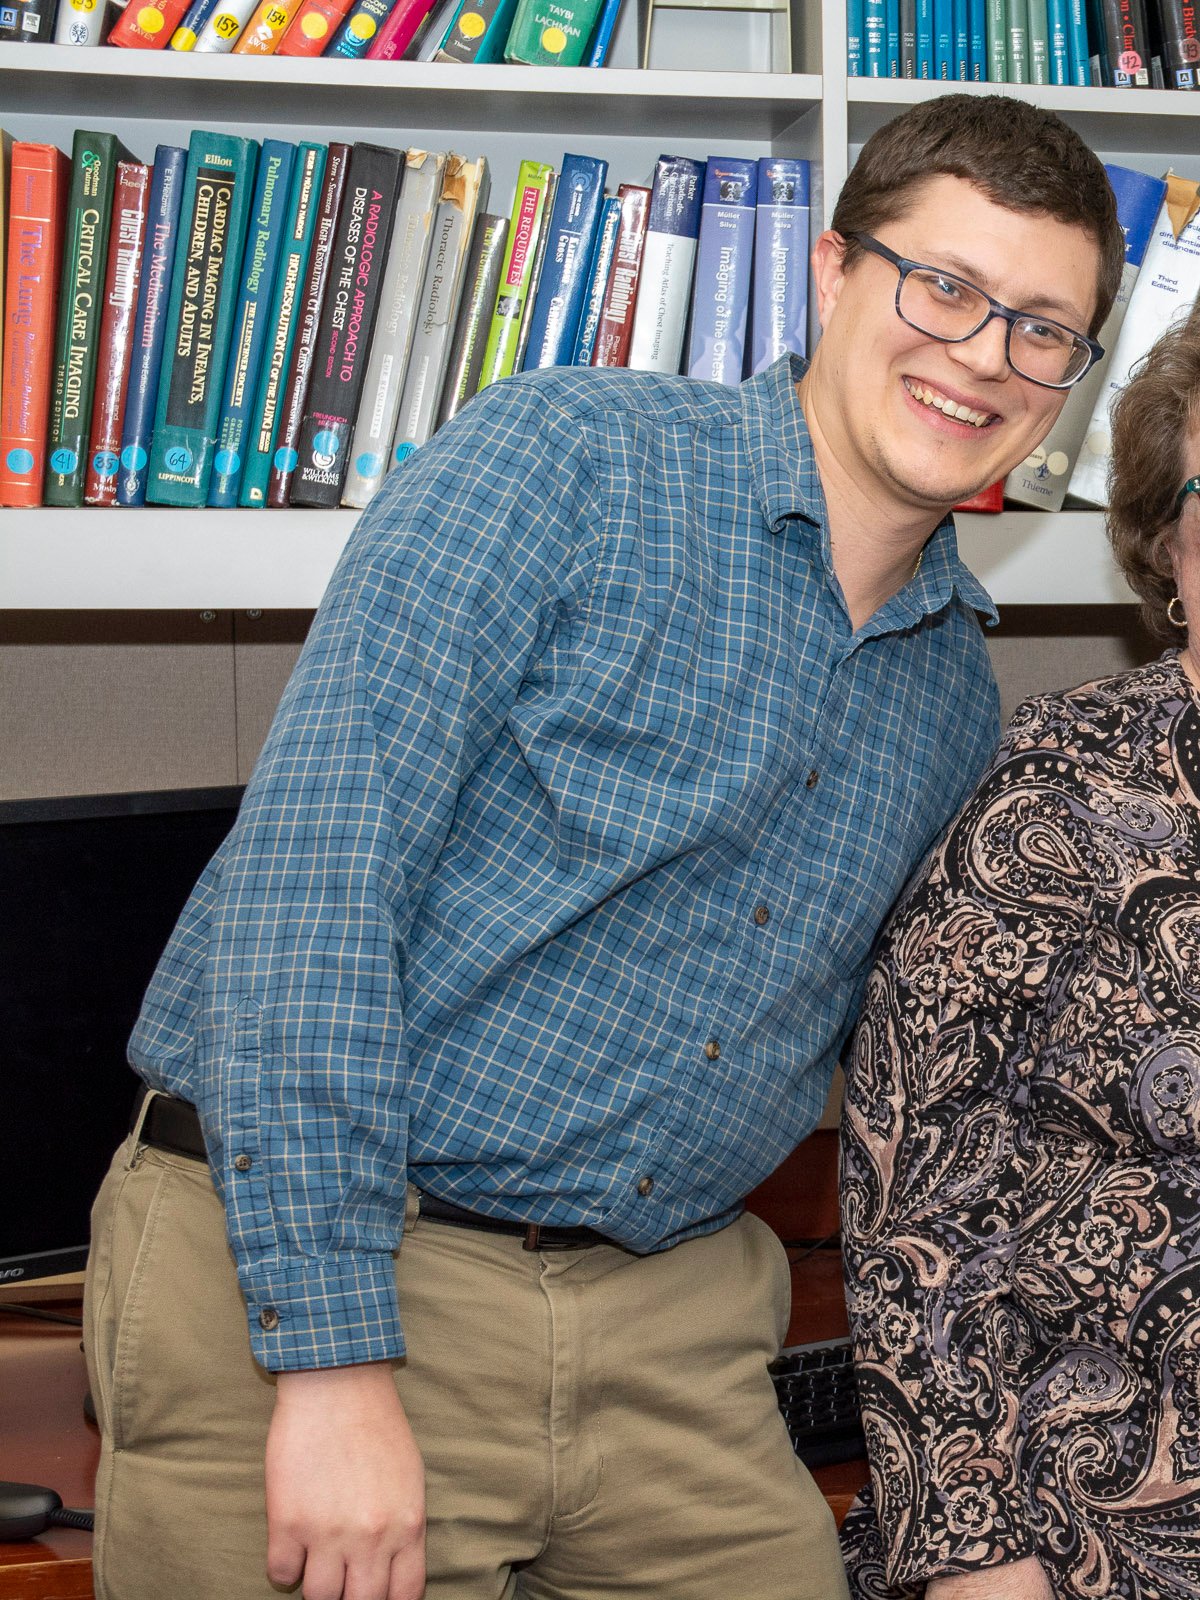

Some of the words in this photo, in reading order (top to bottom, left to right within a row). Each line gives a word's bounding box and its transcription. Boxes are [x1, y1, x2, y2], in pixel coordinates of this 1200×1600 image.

[268, 10, 285, 26] 154
[361, 1, 384, 17] EDITION
[549, 4, 574, 20] TAYBI
[216, 16, 239, 37] 157
[535, 14, 581, 37] LACHMAN
[1122, 56, 1140, 69] 42
[204, 154, 232, 167] Elliott
[257, 156, 282, 228] Pulmonary
[370, 191, 382, 200] A
[686, 175, 697, 200] Parker
[521, 189, 538, 213] THE
[187, 184, 214, 263] CHILDREN,
[210, 187, 231, 253] CARDIAC
[347, 187, 368, 244] DISEASES
[717, 211, 740, 220] Müller
[76, 209, 100, 287] CRITICAL
[154, 223, 170, 250] The
[356, 203, 382, 287] RADIOLOGIC
[435, 214, 454, 271] Thoracic
[1162, 239, 1200, 256] diagnosis
[309, 216, 331, 298] HIGH-RESOLUTION
[344, 247, 357, 265] OF
[509, 216, 531, 284] REQUISITES
[246, 230, 270, 295] Radiology
[772, 246, 789, 302] Imaging
[185, 266, 201, 298] AND
[201, 256, 223, 320] IMAGING
[340, 266, 353, 289] THE
[1151, 280, 1179, 294] Edition
[1158, 274, 1178, 285] Third
[142, 254, 166, 347] Mediastinum
[306, 298, 318, 313] CT
[331, 291, 348, 330] CHEST
[421, 274, 443, 336] Radiology
[773, 305, 786, 319] of
[72, 293, 92, 340] CARE
[304, 313, 313, 326] OF
[344, 288, 366, 362] APPROACH
[178, 301, 199, 357] ADULTS
[201, 323, 213, 340] IN
[301, 327, 311, 344] THE
[774, 320, 785, 338] the
[296, 346, 310, 374] CHEST
[57, 365, 65, 395] THIRD
[65, 346, 88, 418] IMAGING
[188, 344, 213, 404] INFANTS,
[339, 364, 354, 382] TO
[53, 400, 62, 441] EDITION
[55, 453, 71, 469] 41
[95, 458, 117, 469] 35
[169, 452, 187, 469] 64
[303, 467, 340, 481] WILLIAMS
